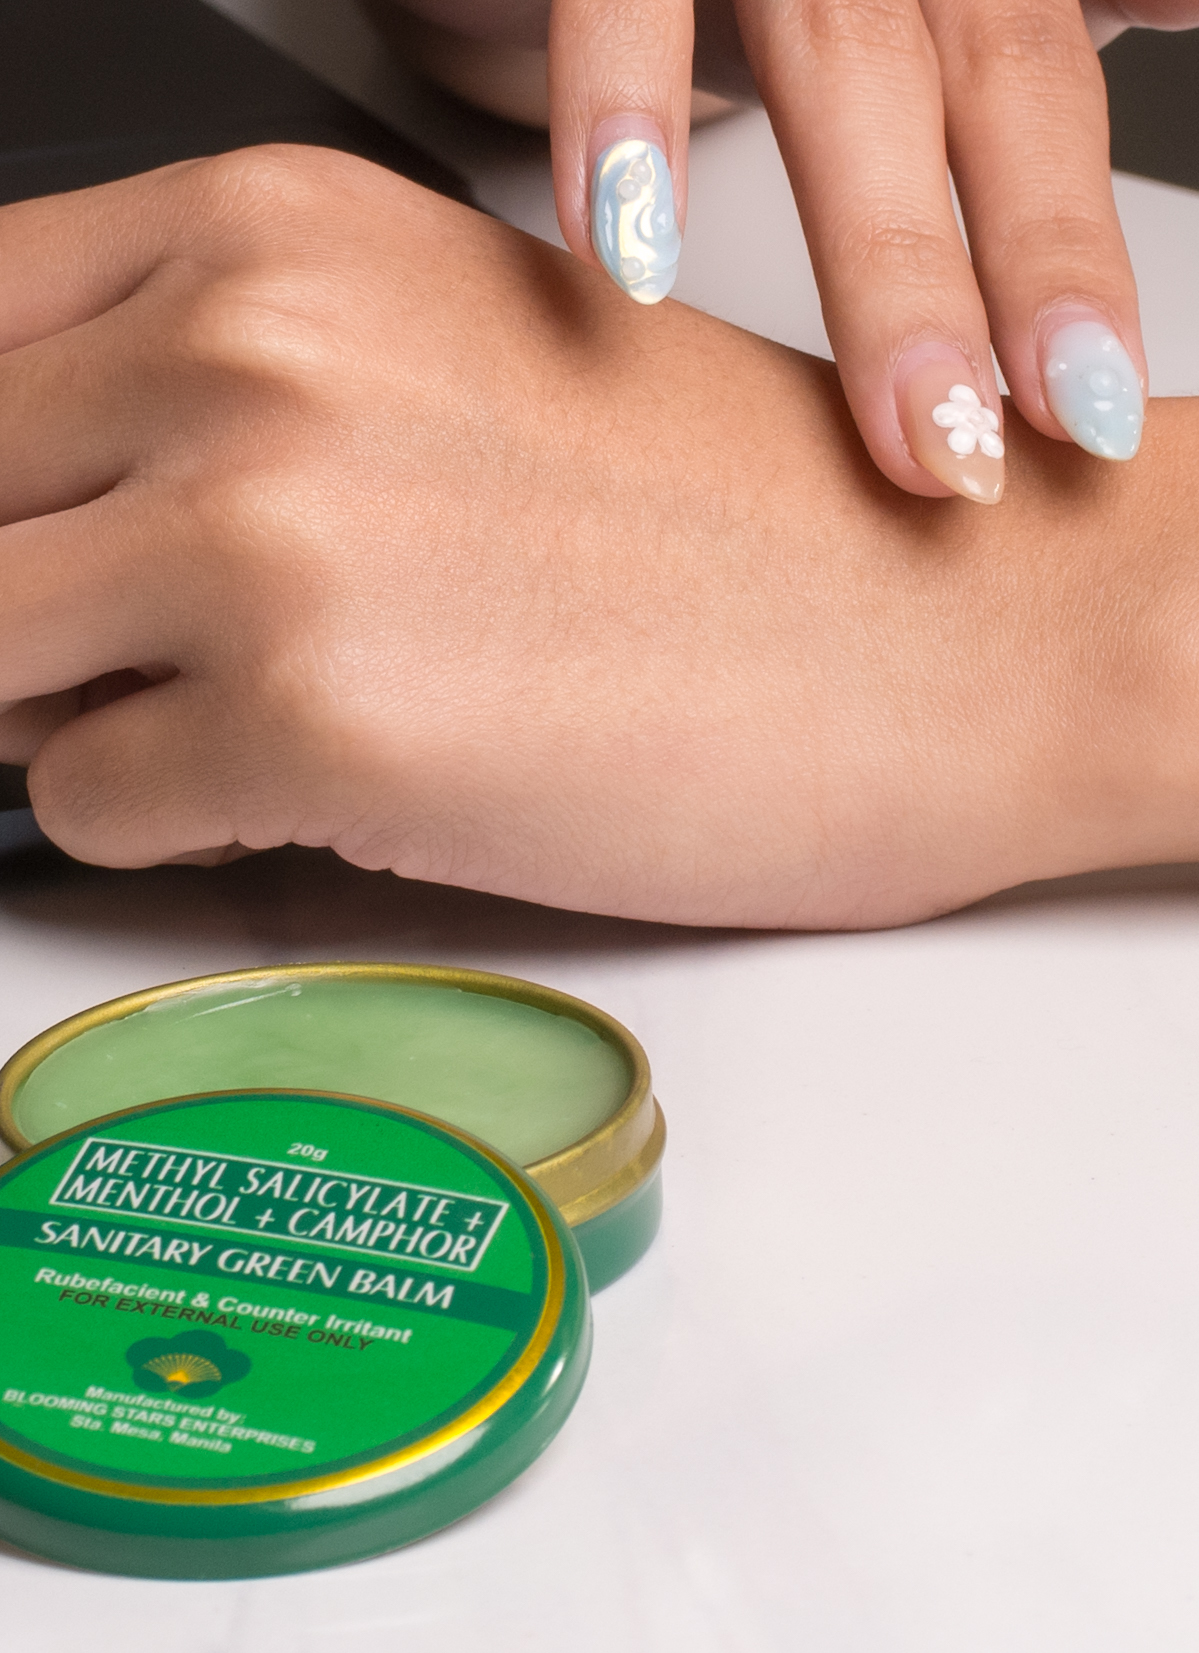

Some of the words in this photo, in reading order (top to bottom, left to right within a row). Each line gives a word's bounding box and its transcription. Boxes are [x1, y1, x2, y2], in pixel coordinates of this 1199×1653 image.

[287, 1142, 329, 1162] 20g
[63, 1174, 241, 1224] MENTHOL
[255, 1209, 275, 1229] +
[287, 1207, 477, 1264] CAMPHOR
[85, 1146, 227, 1189] METHYL
[239, 1167, 456, 1226] SALICYLATE
[464, 1212, 484, 1231] +
[33, 1221, 214, 1266] SANITARY
[216, 1248, 343, 1289] GREEN
[347, 1268, 456, 1310] BALM
[34, 1267, 186, 1304] Rubefacient
[190, 1291, 211, 1308] &
[217, 1296, 321, 1327] Counter
[325, 1314, 413, 1345] Irritant
[58, 1289, 110, 1308] FOR
[115, 1298, 242, 1330] EXTERNAL
[251, 1320, 301, 1340] USE
[306, 1329, 375, 1351] ONLY
[2, 1388, 108, 1416] BLOOMING
[111, 1405, 176, 1427] STARS
[179, 1416, 316, 1454] ENTERPRISES
[85, 1384, 215, 1418] Manufactured
[168, 1430, 232, 1454] Manila
